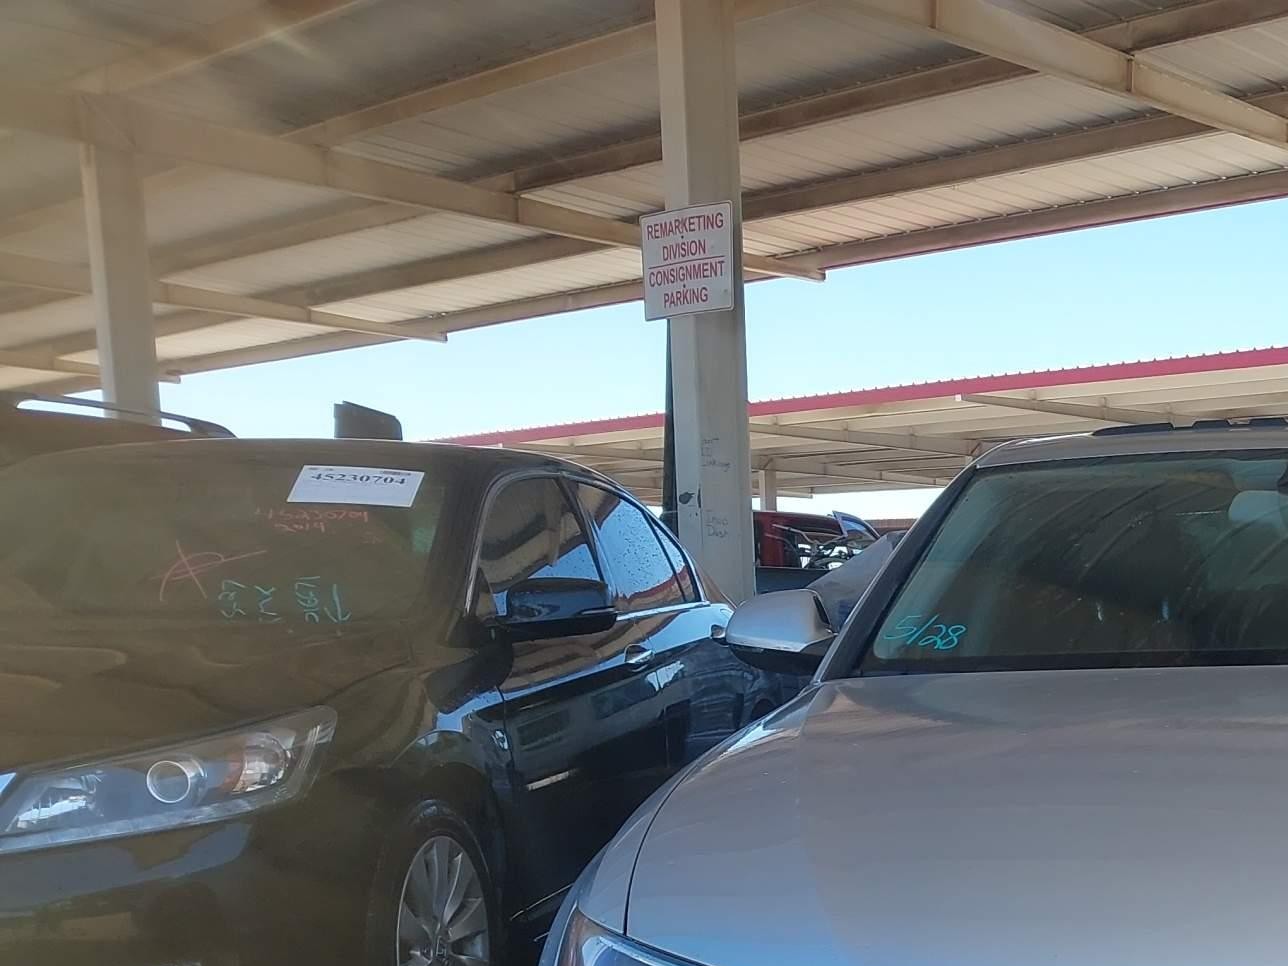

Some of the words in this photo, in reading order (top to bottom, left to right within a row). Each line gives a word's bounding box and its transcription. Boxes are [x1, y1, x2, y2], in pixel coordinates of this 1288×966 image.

[646, 212, 724, 240] REMARKETING
[662, 239, 706, 261] DIVISION
[648, 260, 725, 288] CONSIGNMENT
[663, 286, 709, 309] PARKING
[310, 473, 406, 485] 45230704
[883, 614, 967, 650] 5/28
